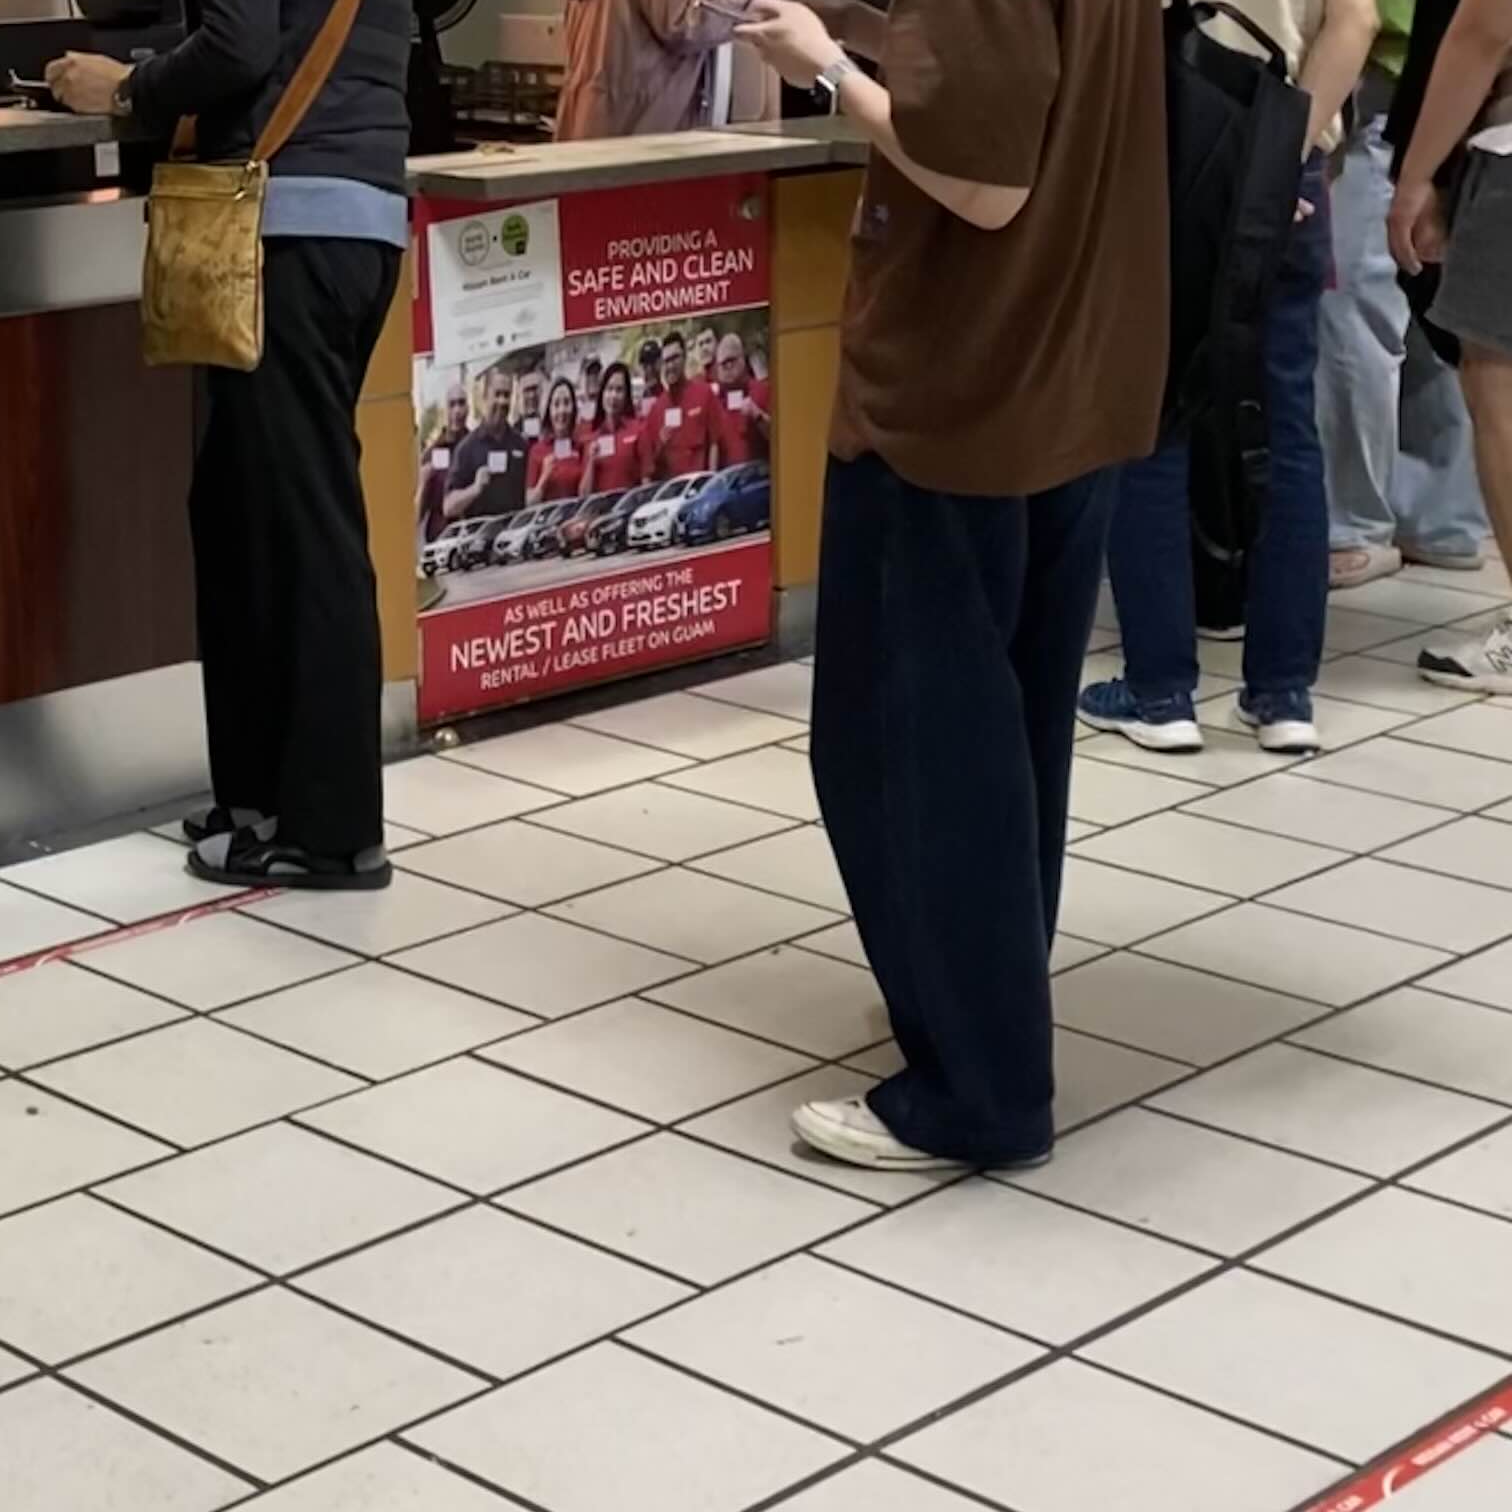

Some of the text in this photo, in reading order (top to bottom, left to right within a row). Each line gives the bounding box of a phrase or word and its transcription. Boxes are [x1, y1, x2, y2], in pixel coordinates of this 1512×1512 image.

[607, 228, 719, 261] PROVIDING A
[568, 248, 754, 297] SAFE AND CLEAN
[594, 280, 731, 320] ENVIRONMENT
[504, 567, 695, 626] AS WELL AS OFFERING THE
[451, 579, 743, 673] NEWEST AND FRESHEST
[480, 619, 717, 691] RENTAL / LEASE FLEET ON GUAM
